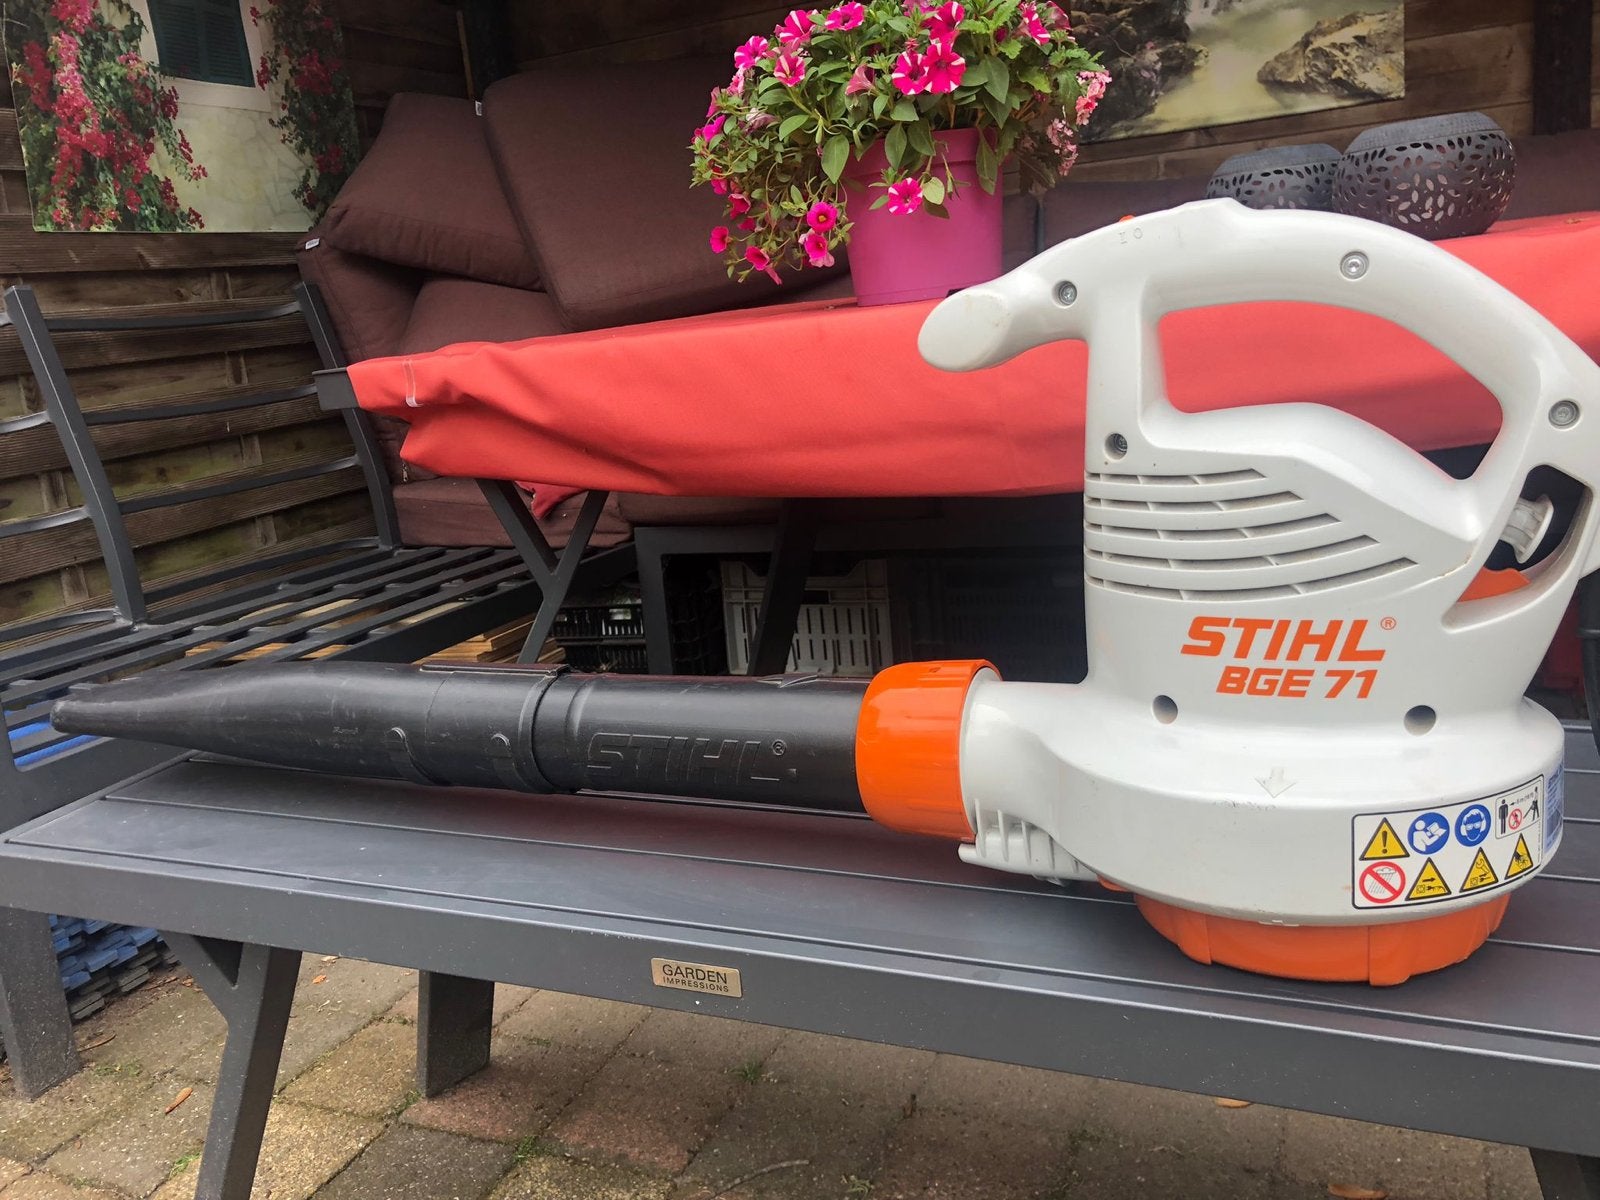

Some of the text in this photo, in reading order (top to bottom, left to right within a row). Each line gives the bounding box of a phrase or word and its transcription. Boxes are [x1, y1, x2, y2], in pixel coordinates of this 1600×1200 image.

[1180, 615, 1387, 662] STIHL
[1215, 665, 1379, 699] BGE 71
[586, 731, 781, 784] STIHL
[662, 964, 728, 985] GARDEN
[662, 976, 730, 993] IMPRESSIONS
